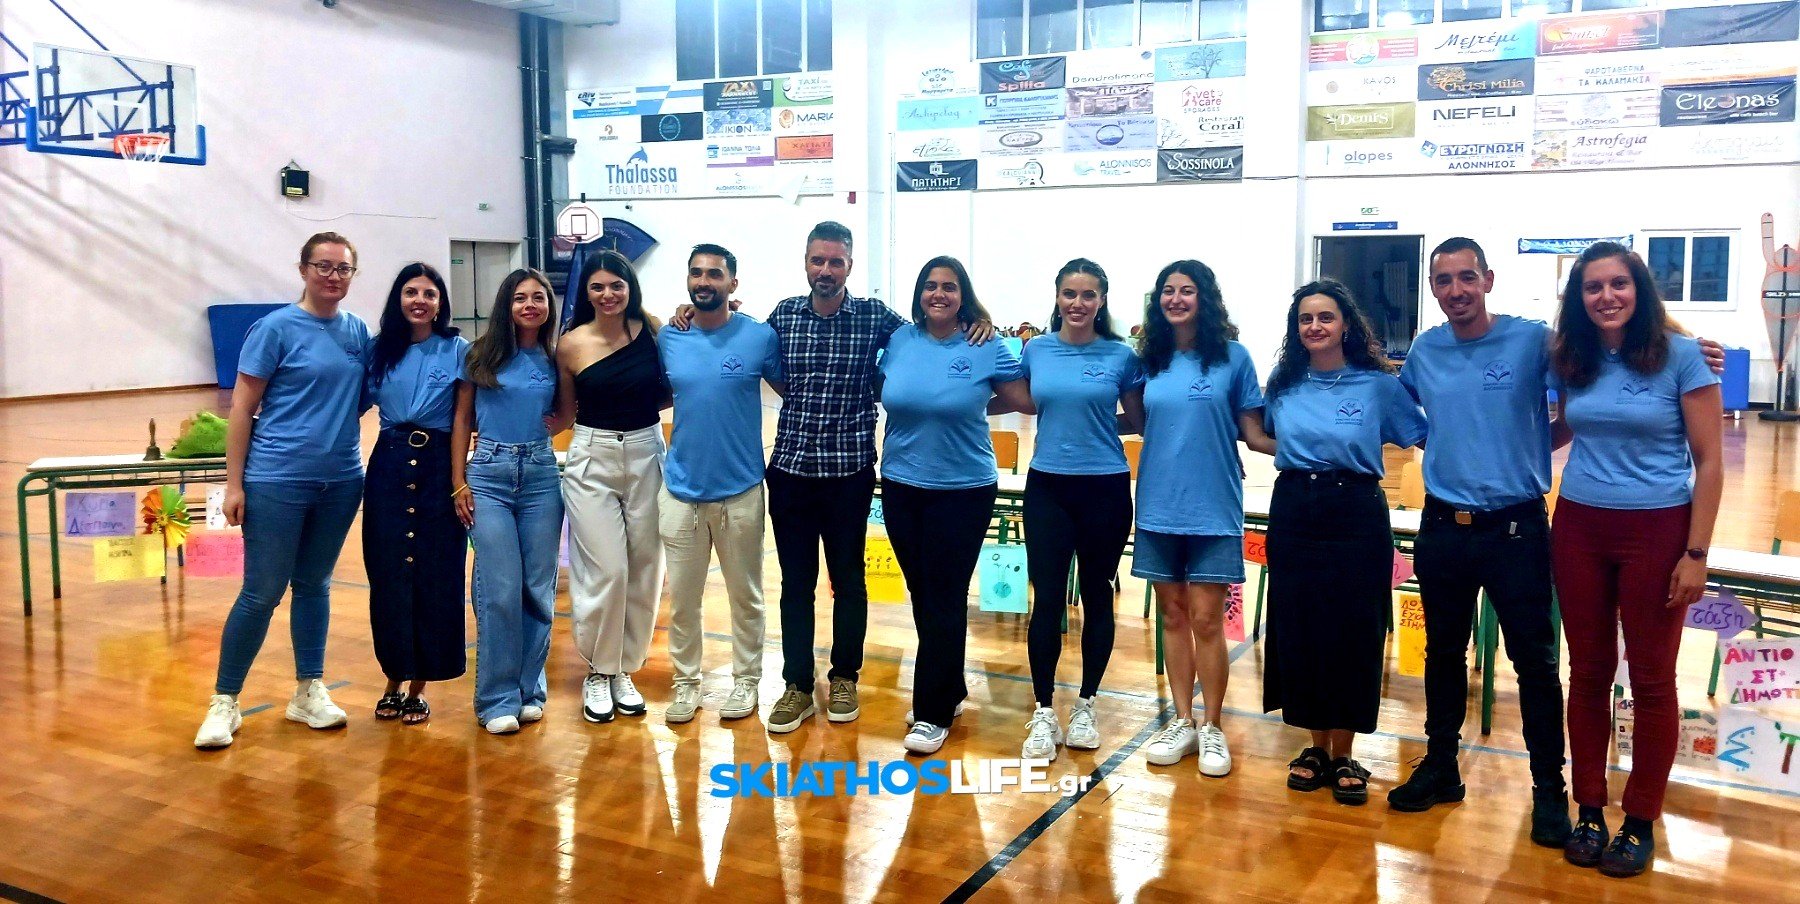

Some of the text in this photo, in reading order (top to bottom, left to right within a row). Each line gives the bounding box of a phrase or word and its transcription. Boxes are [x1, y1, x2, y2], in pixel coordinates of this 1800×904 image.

[1196, 89, 1215, 99] vet
[1199, 98, 1222, 107] care
[1676, 93, 1780, 111] Eleonas
[1433, 106, 1516, 121] NEFELI
[725, 125, 751, 133] IKION
[1572, 133, 1647, 148] Astrofegia
[1440, 144, 1524, 156] ΕΥΡΩΓΝΩΣΗ
[1167, 153, 1234, 170] SOSSINOLA
[1448, 160, 1516, 170] ΑΛΟΝΝΗΣΟΣ
[605, 164, 678, 184] Thalassa
[912, 177, 961, 187] ΠΑΤΗΤΗΡΙ
[609, 185, 678, 195] FOUNDATION
[1692, 603, 1746, 629] τάξη
[1724, 647, 1794, 665] ΑΝΤΙΟ
